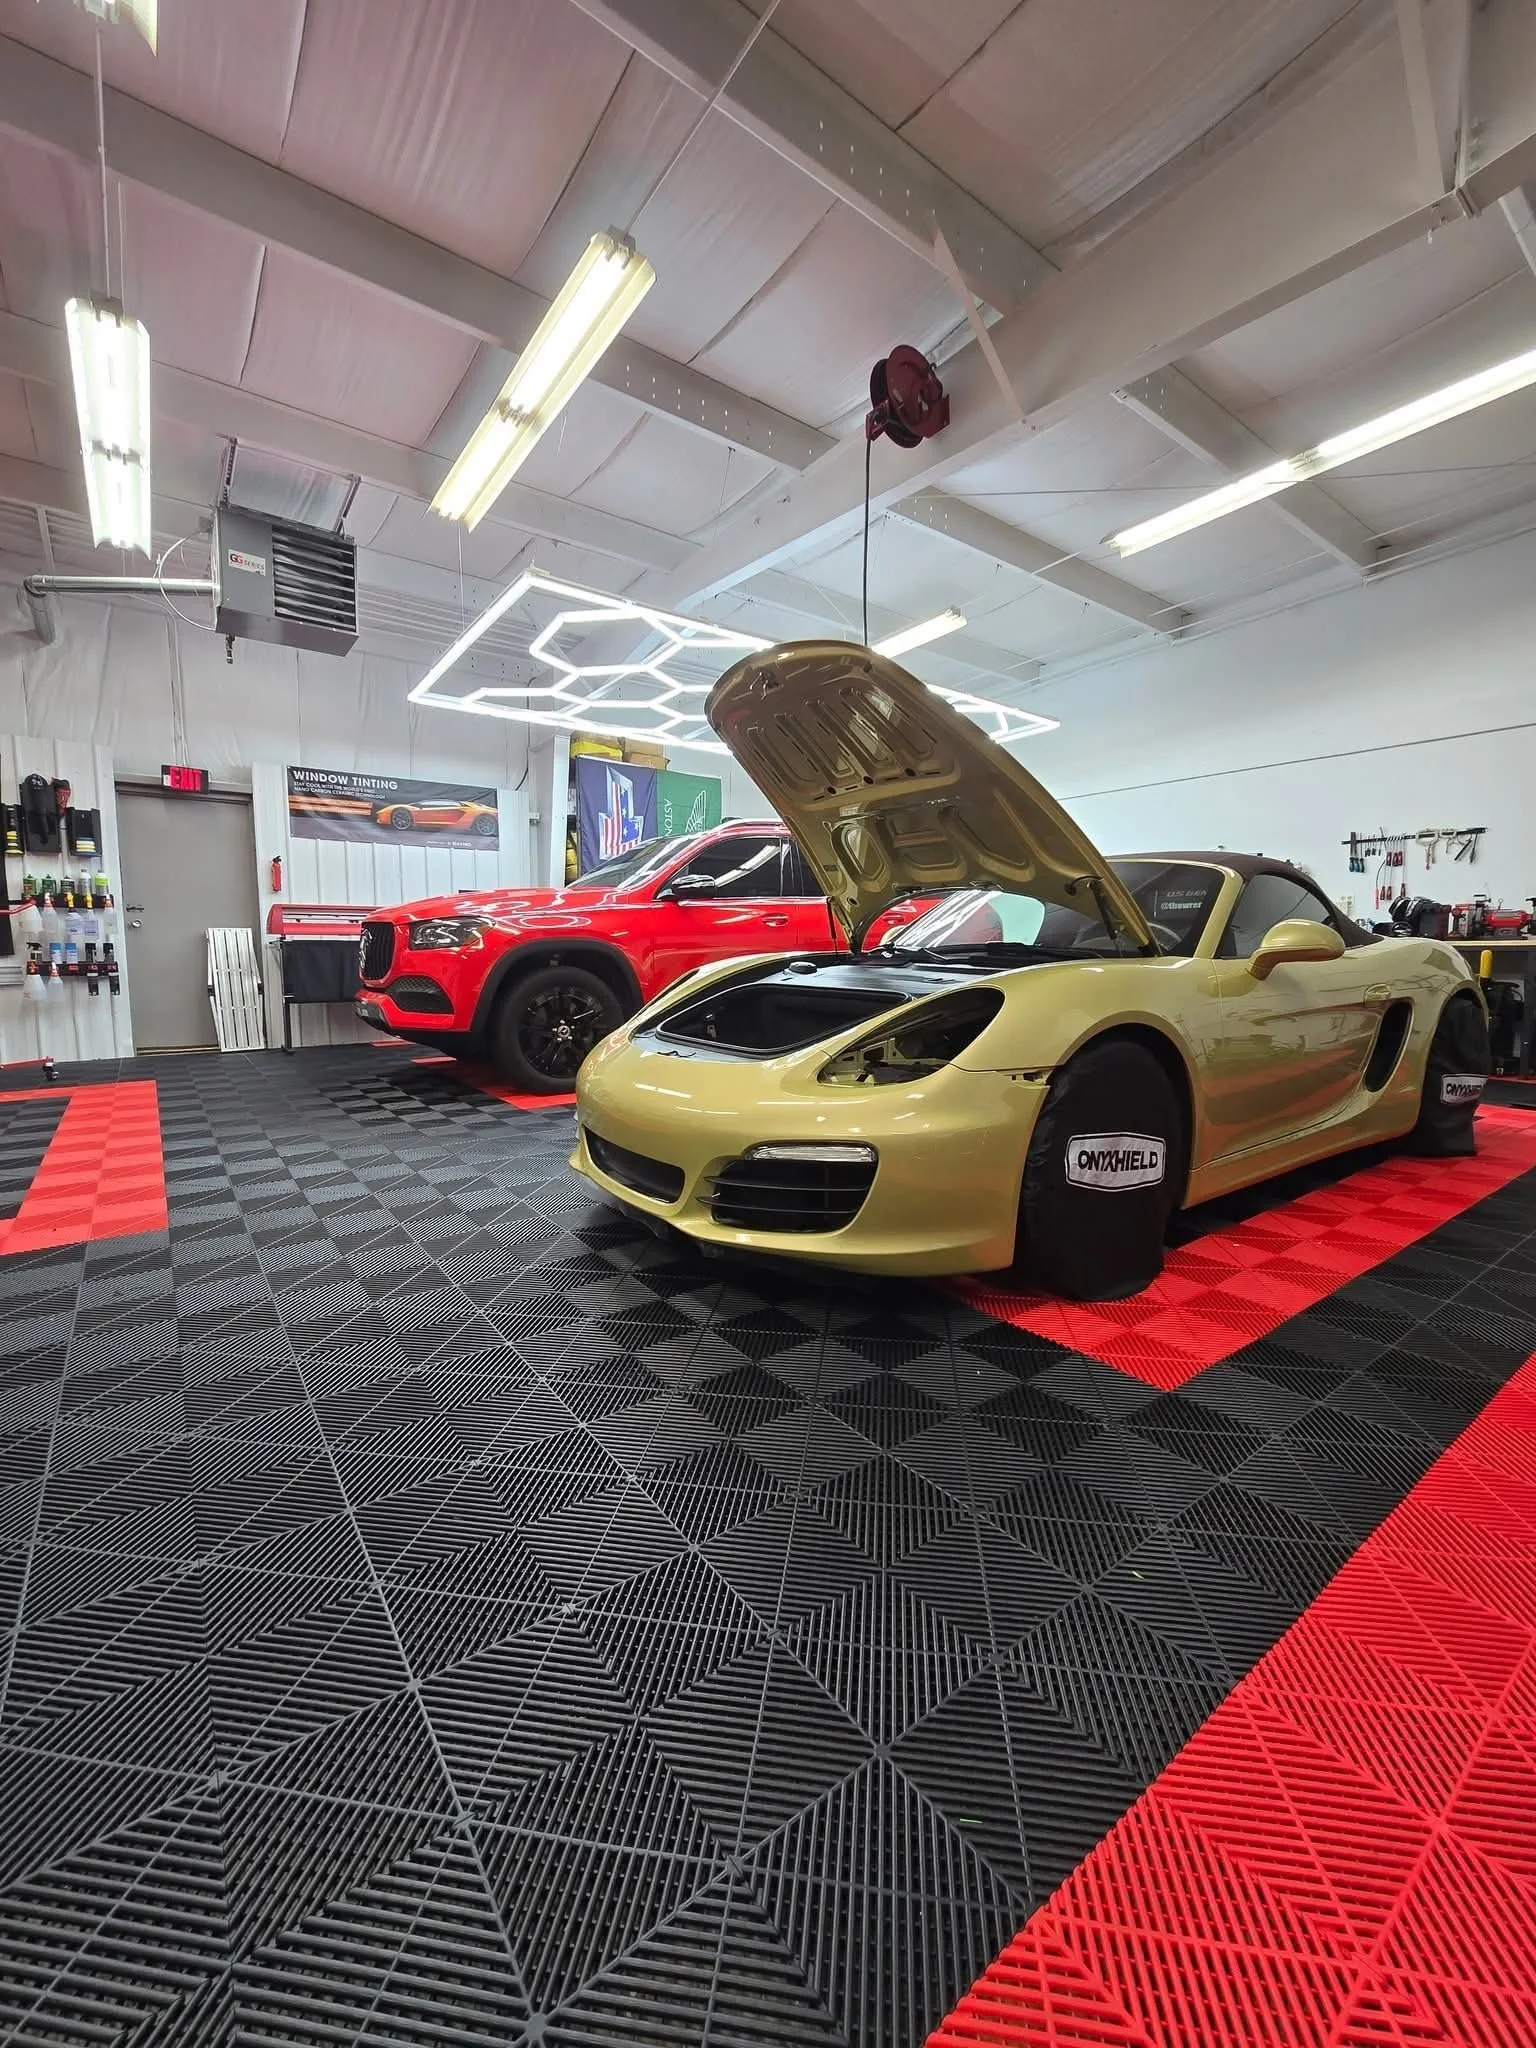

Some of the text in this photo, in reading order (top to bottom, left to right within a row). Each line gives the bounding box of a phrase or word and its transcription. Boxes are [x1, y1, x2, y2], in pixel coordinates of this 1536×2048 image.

[170, 767, 202, 791] EXIT
[293, 770, 398, 790] WINDOW TINTING
[664, 798, 673, 837] ASTON
[1078, 1150, 1158, 1172] ONYXHIELD
